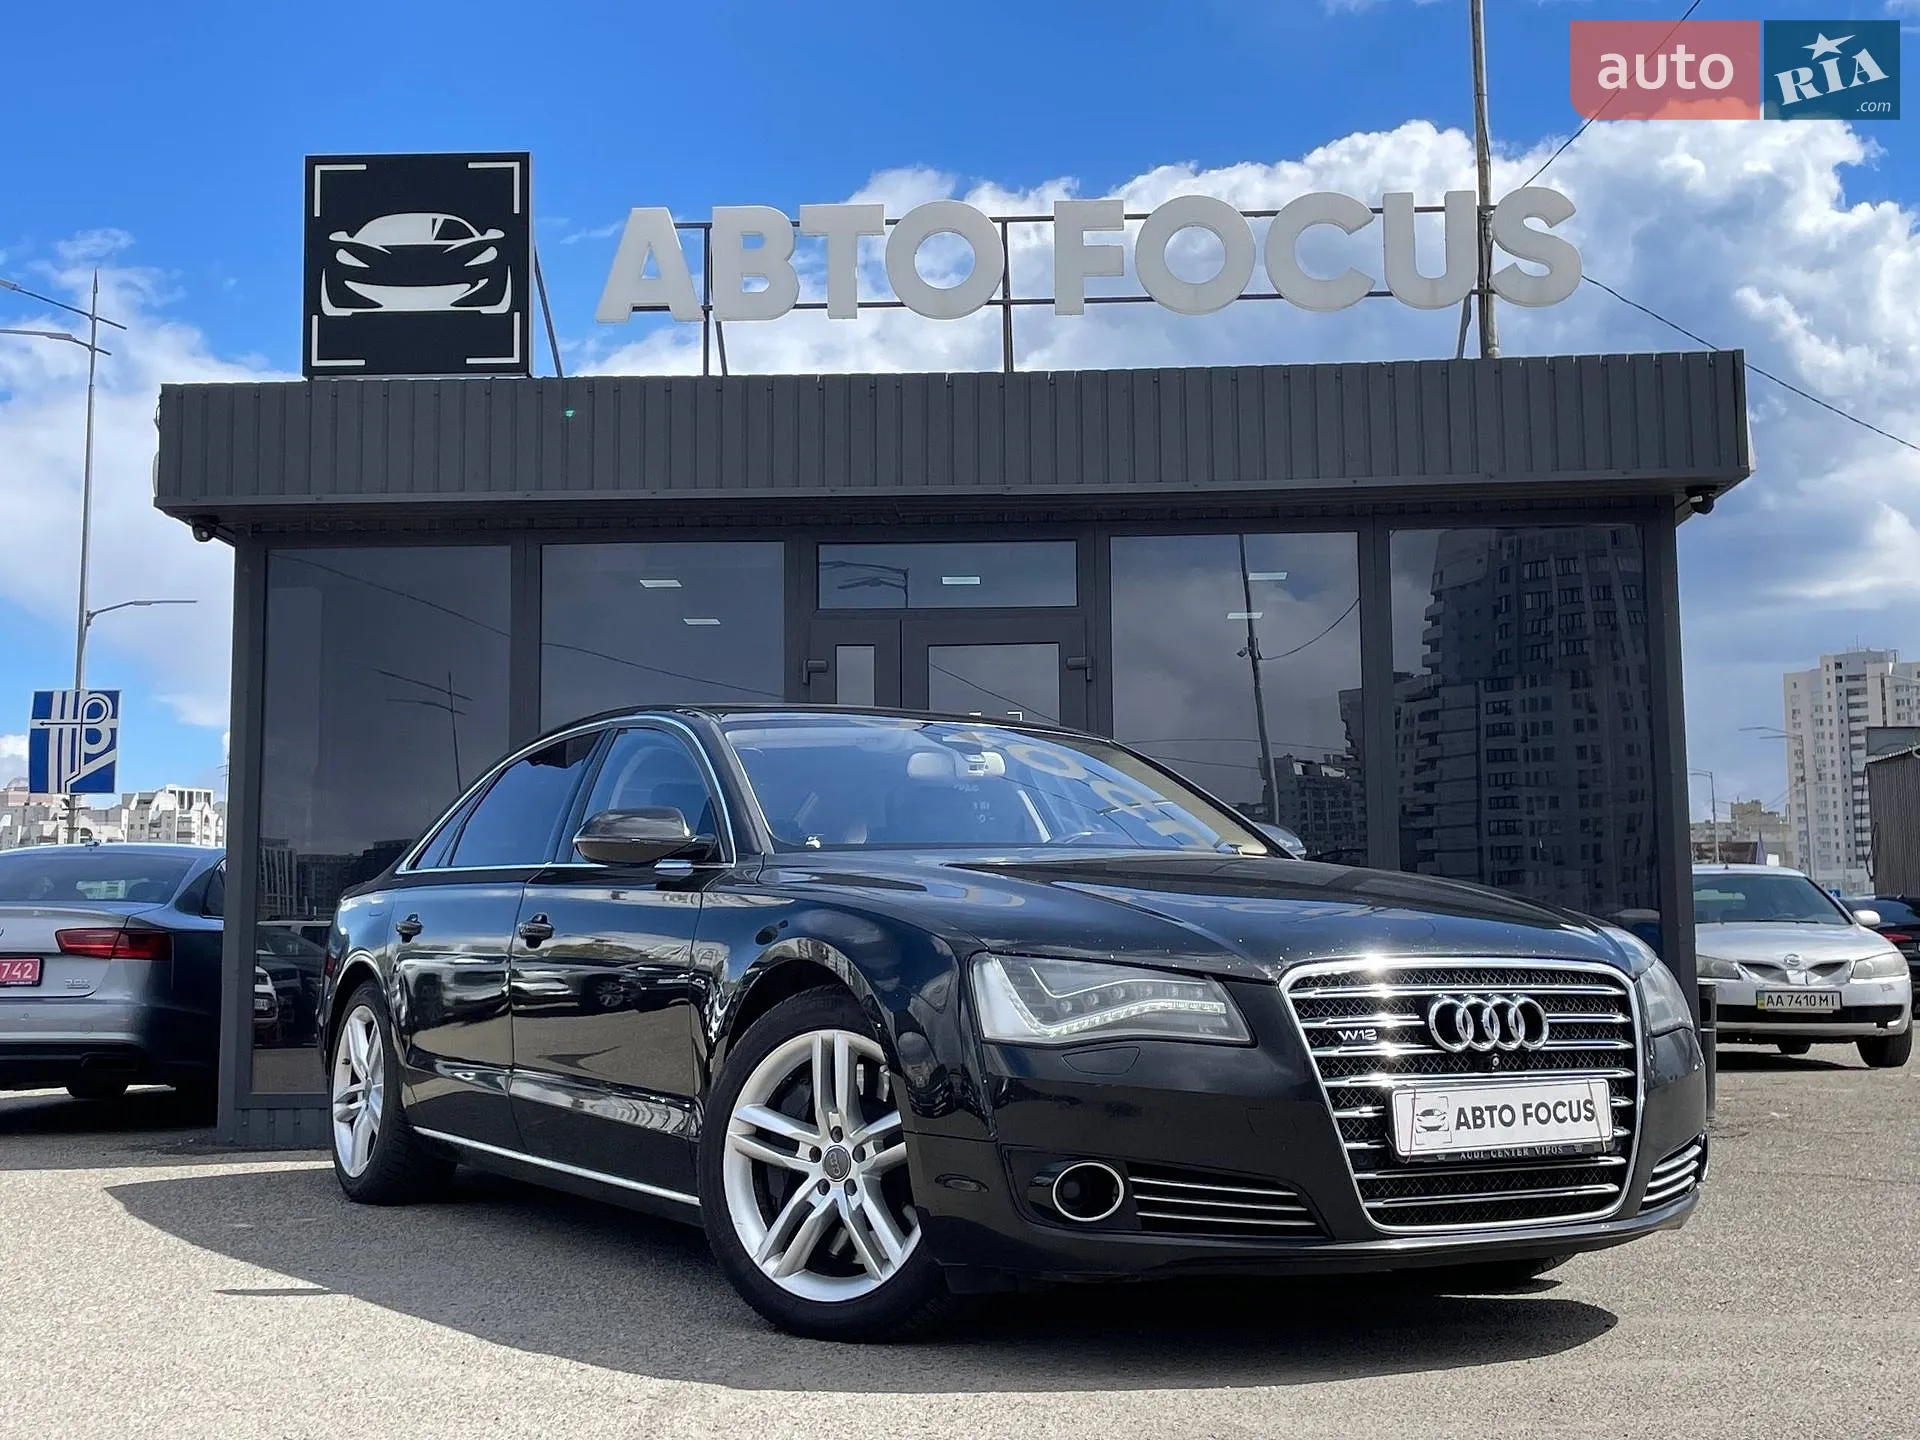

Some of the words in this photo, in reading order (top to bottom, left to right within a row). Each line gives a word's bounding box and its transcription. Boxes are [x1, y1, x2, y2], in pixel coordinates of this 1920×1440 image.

[594, 199, 1006, 323] АВТО
[1053, 186, 1583, 317] FOCUS
[2, 962, 33, 979] 742
[1337, 1028, 1378, 1041] W12
[1455, 1103, 1516, 1131] АВТО
[1522, 1098, 1596, 1126] FOCUS
[1460, 1151, 1485, 1160] AUDI
[1490, 1147, 1529, 1158] CENTER
